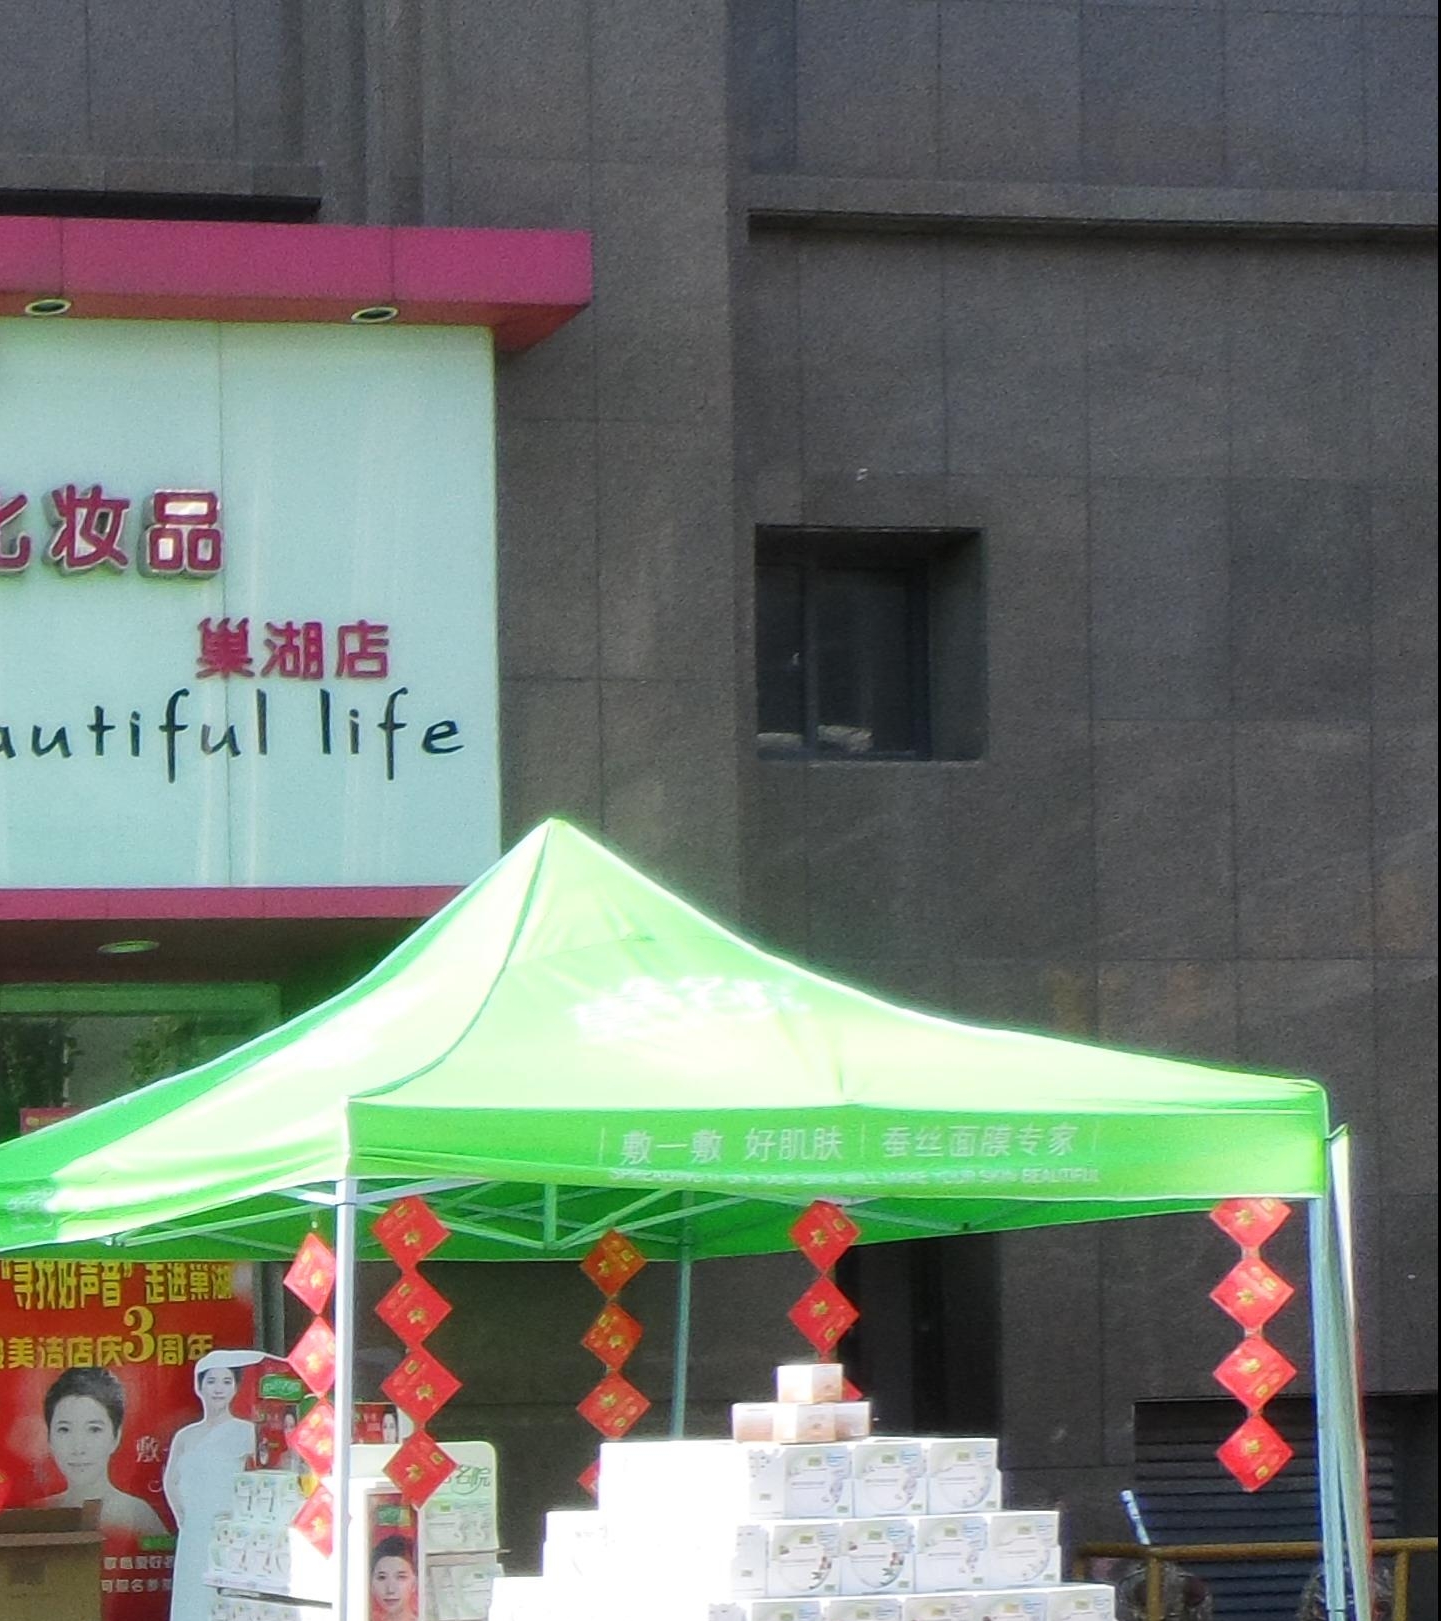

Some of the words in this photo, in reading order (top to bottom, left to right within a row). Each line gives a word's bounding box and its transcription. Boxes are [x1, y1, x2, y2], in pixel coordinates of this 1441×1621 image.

[193, 615, 392, 683] 巢湖店
[318, 688, 467, 782] life
[620, 1128, 724, 1166] 敷一敷
[744, 1126, 844, 1163] 好肌肤
[882, 1122, 1079, 1158] 蚕丝面膜专家
